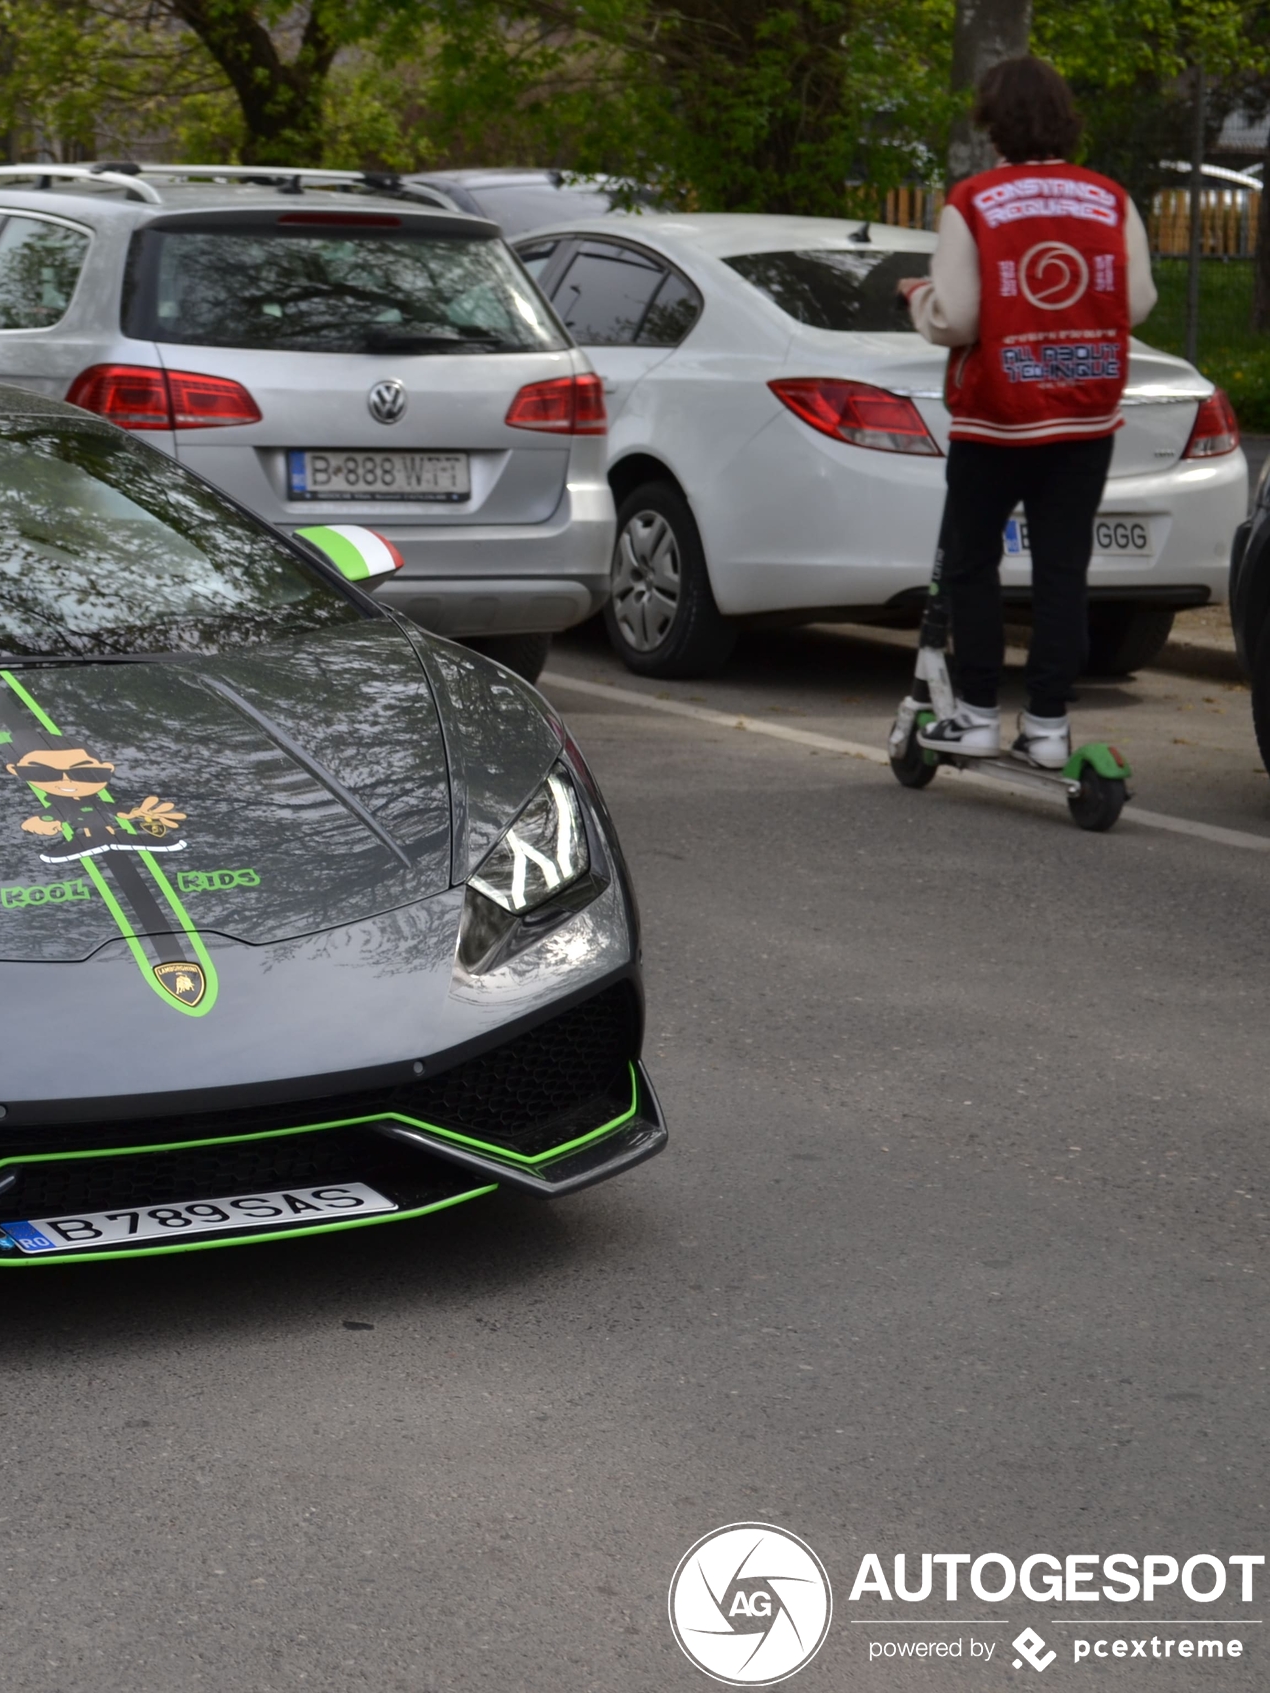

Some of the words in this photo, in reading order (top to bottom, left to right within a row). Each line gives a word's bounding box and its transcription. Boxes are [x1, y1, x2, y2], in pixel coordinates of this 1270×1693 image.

[1001, 346, 1034, 364] ALL
[1041, 342, 1121, 362] ABOUT
[311, 455, 331, 486] B
[344, 456, 396, 486] 888
[1096, 523, 1147, 549] GGG
[0, 879, 91, 909] KOOL
[177, 868, 261, 892] KIDS
[19, 1236, 50, 1249] RO
